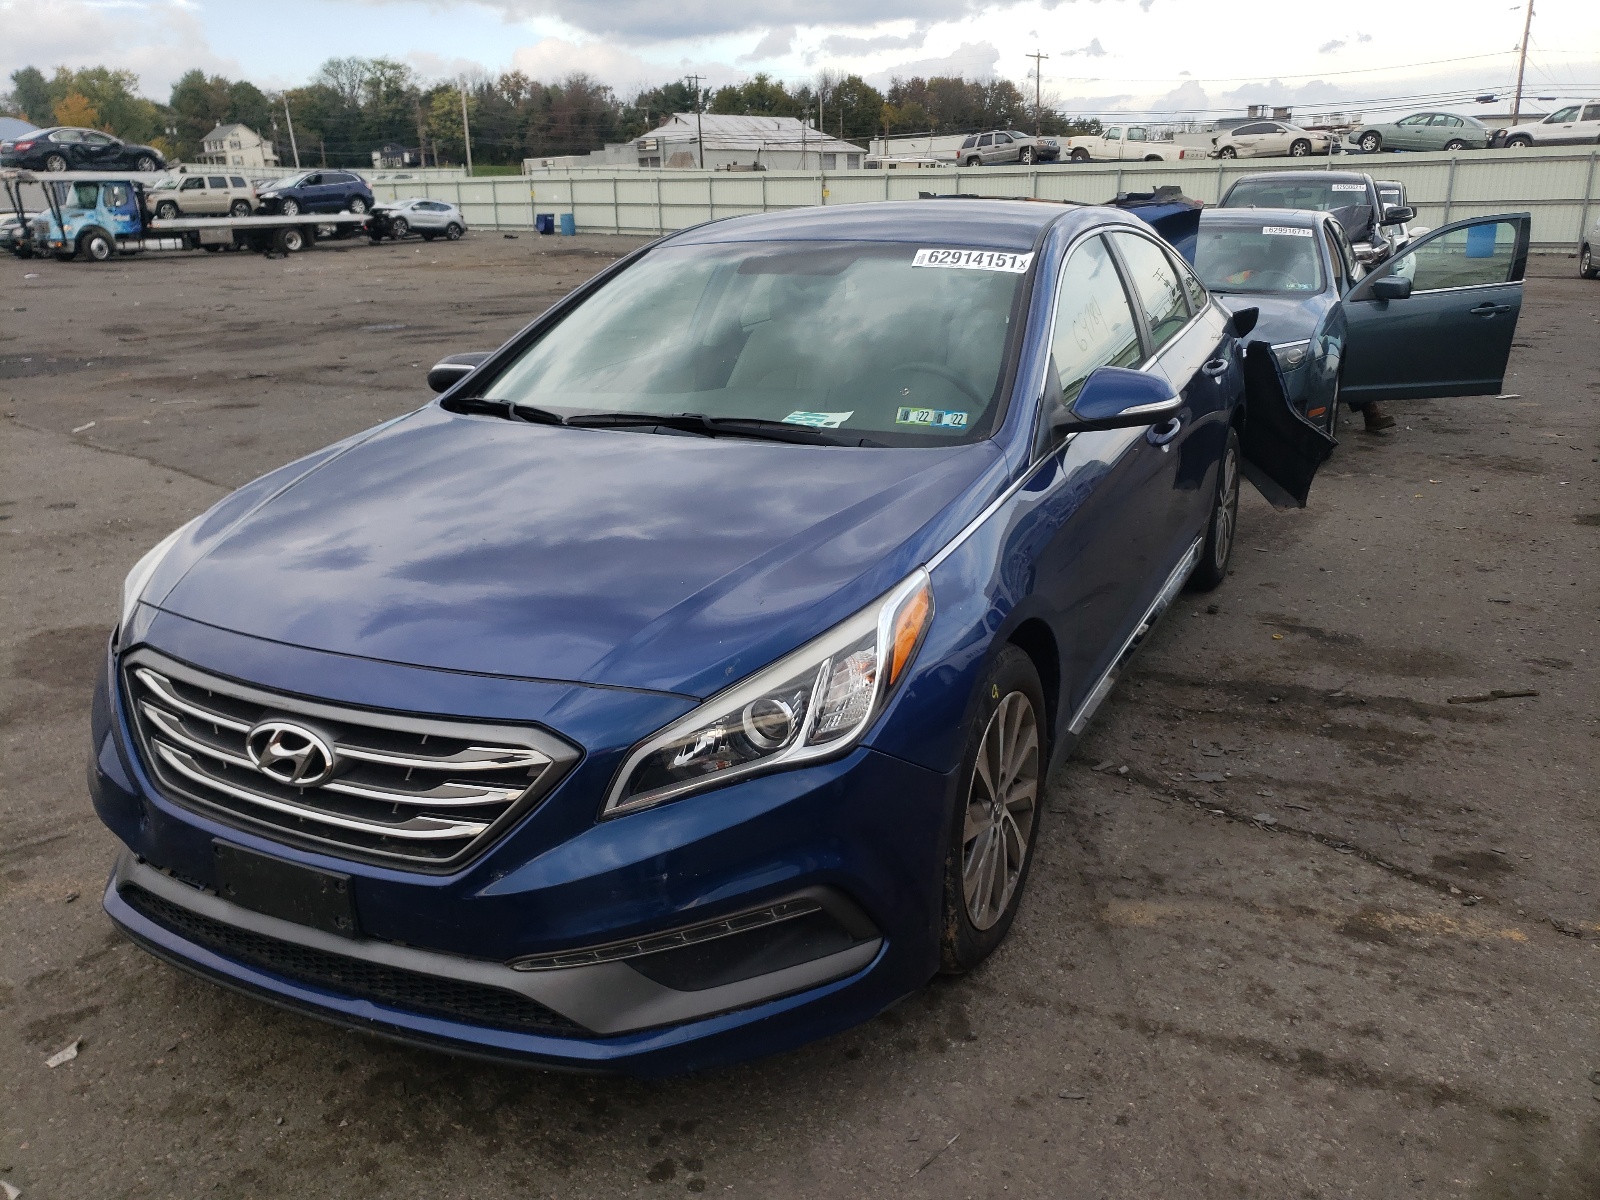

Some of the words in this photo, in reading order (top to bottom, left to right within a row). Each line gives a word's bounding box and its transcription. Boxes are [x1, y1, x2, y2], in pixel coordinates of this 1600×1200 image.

[927, 250, 1017, 269] 62914151
[918, 410, 930, 422] 22
[952, 413, 964, 425] 22
